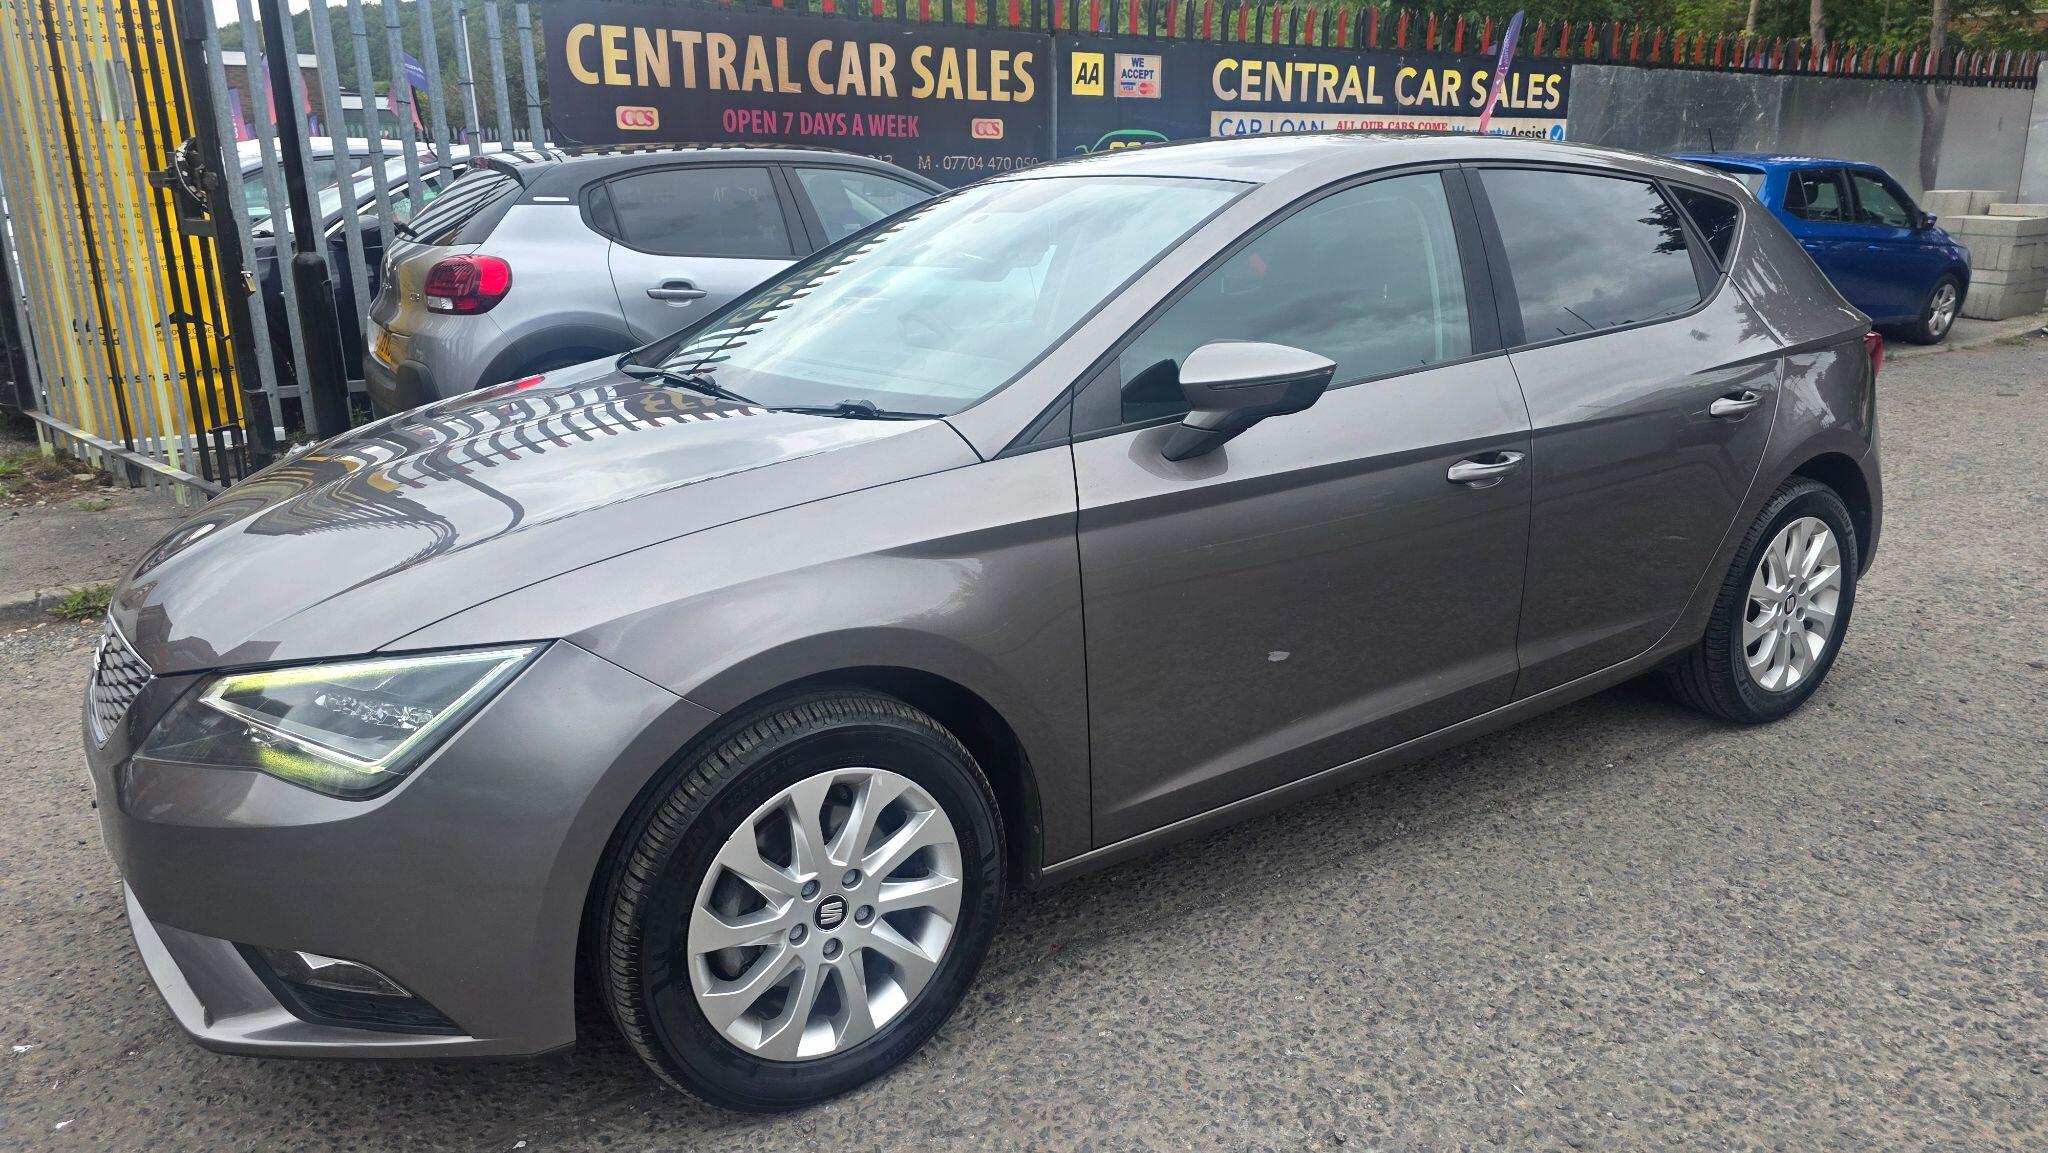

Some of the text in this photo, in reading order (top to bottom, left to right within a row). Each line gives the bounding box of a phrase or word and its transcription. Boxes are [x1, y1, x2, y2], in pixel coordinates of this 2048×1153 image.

[565, 23, 1035, 103] CENTRAL CAR SALES
[1131, 57, 1144, 68] WE
[1075, 62, 1099, 85] AA
[1121, 68, 1155, 79] ACCEPT
[1212, 58, 1562, 111] CENTRAL CAR SALES
[722, 108, 920, 138] OPEN 7 DAYS A WEEK
[1219, 117, 1262, 136] CAR
[918, 155, 931, 170] M
[943, 155, 983, 170] 07704
[988, 156, 1011, 170] 470
